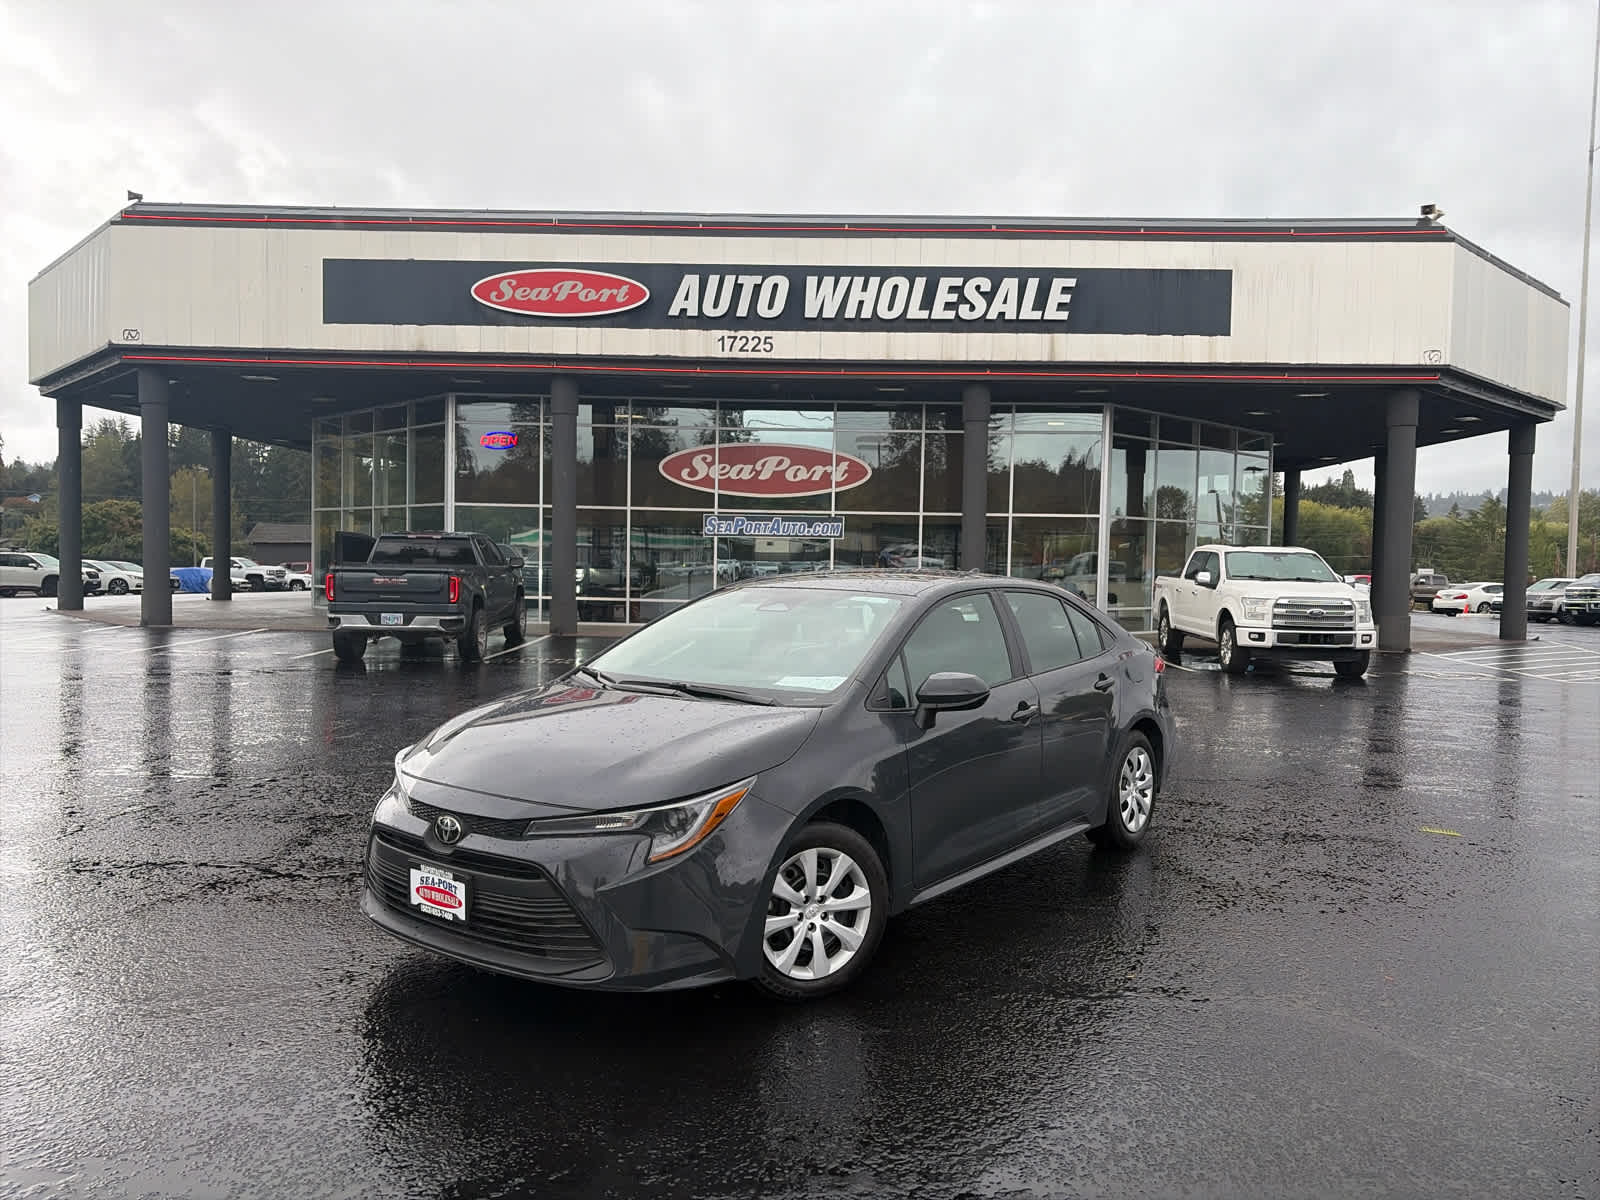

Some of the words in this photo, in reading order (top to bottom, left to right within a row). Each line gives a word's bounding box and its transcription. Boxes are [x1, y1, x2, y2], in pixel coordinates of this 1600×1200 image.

[490, 278, 630, 304] SeaPort
[668, 274, 789, 318] AUTO
[804, 275, 1078, 321] WHOLESALE
[717, 335, 774, 353] 17225
[480, 434, 519, 447] OPEN
[680, 453, 850, 482] SeaPort
